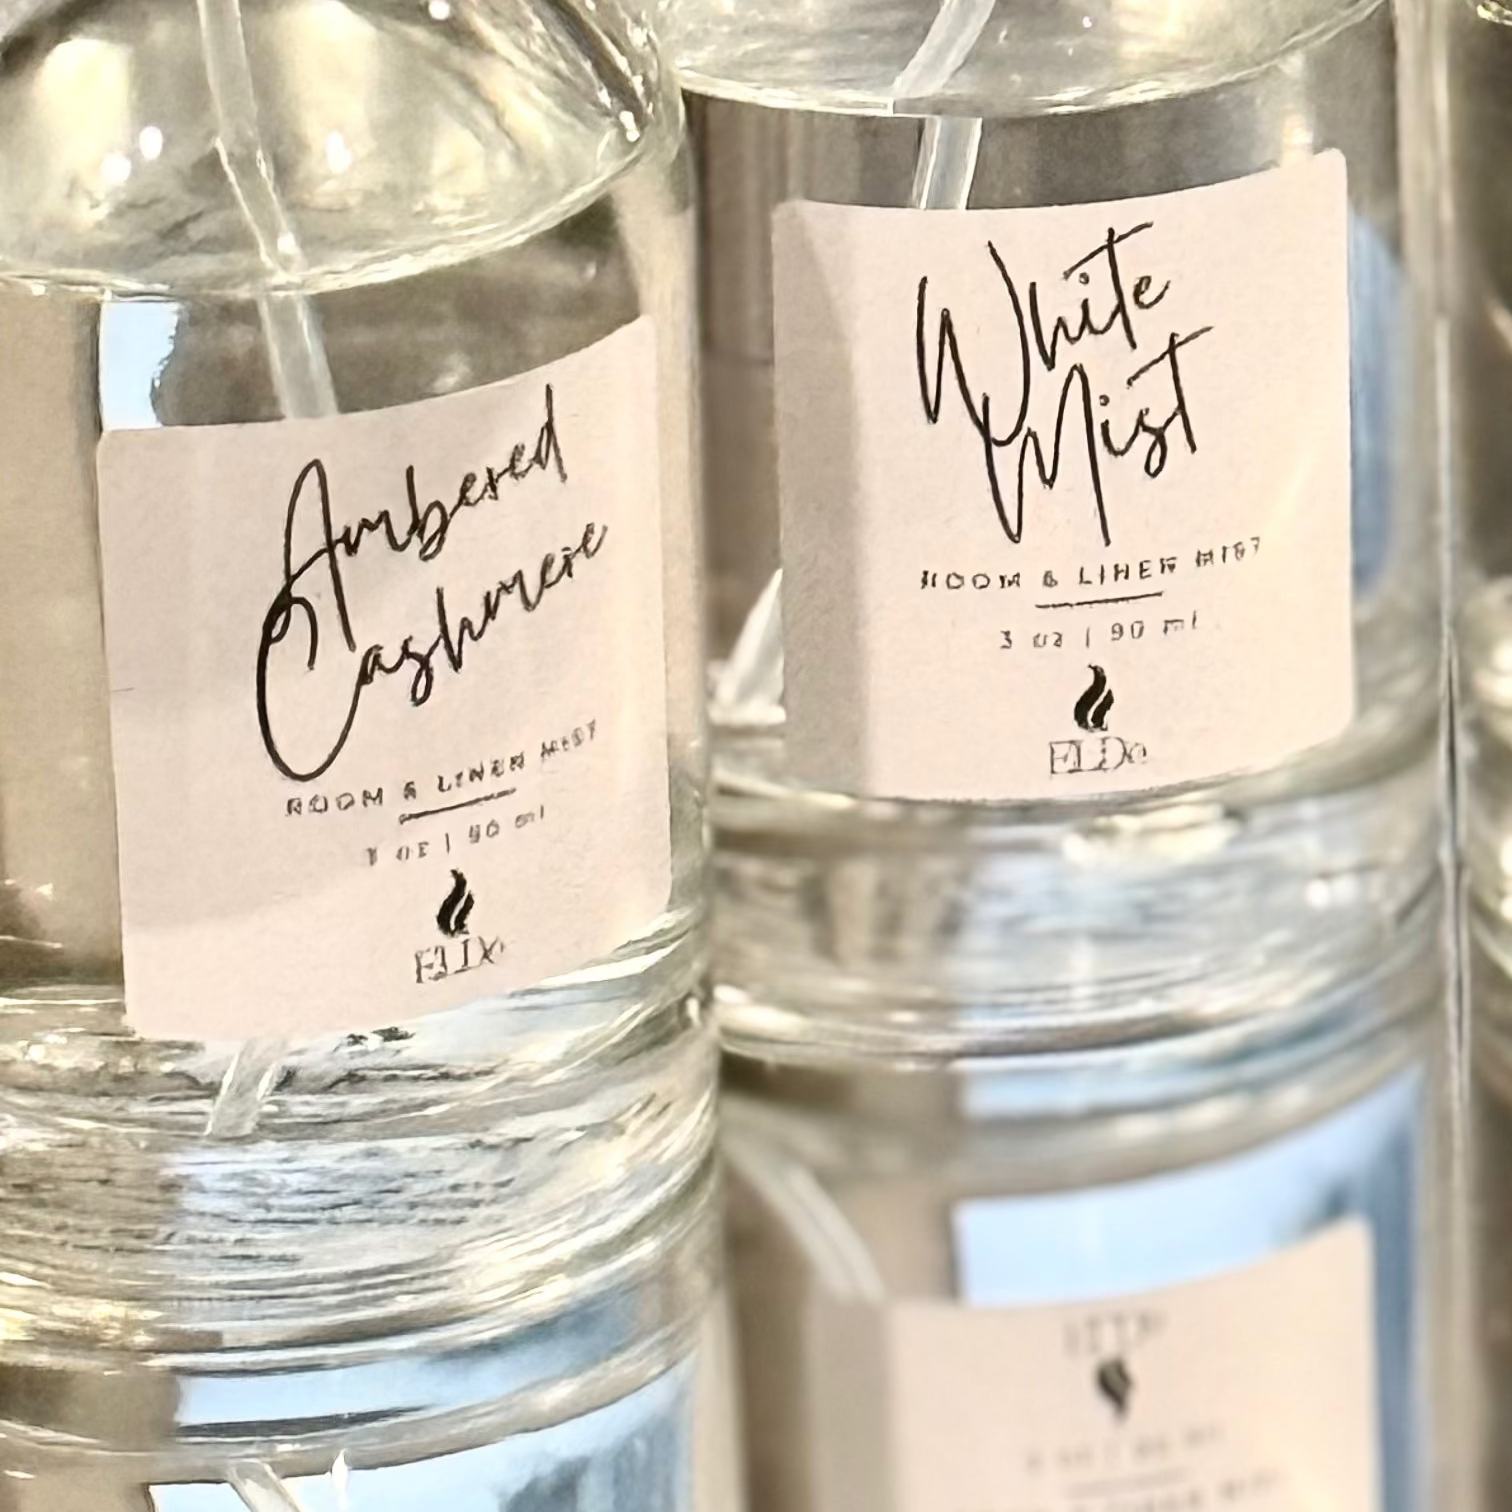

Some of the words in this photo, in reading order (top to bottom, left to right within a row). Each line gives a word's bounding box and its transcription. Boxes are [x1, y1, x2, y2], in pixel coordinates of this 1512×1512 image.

[917, 222, 1171, 446] White
[983, 326, 1214, 546] Mist
[268, 384, 566, 651] Ambered
[256, 523, 608, 782] Cashmere
